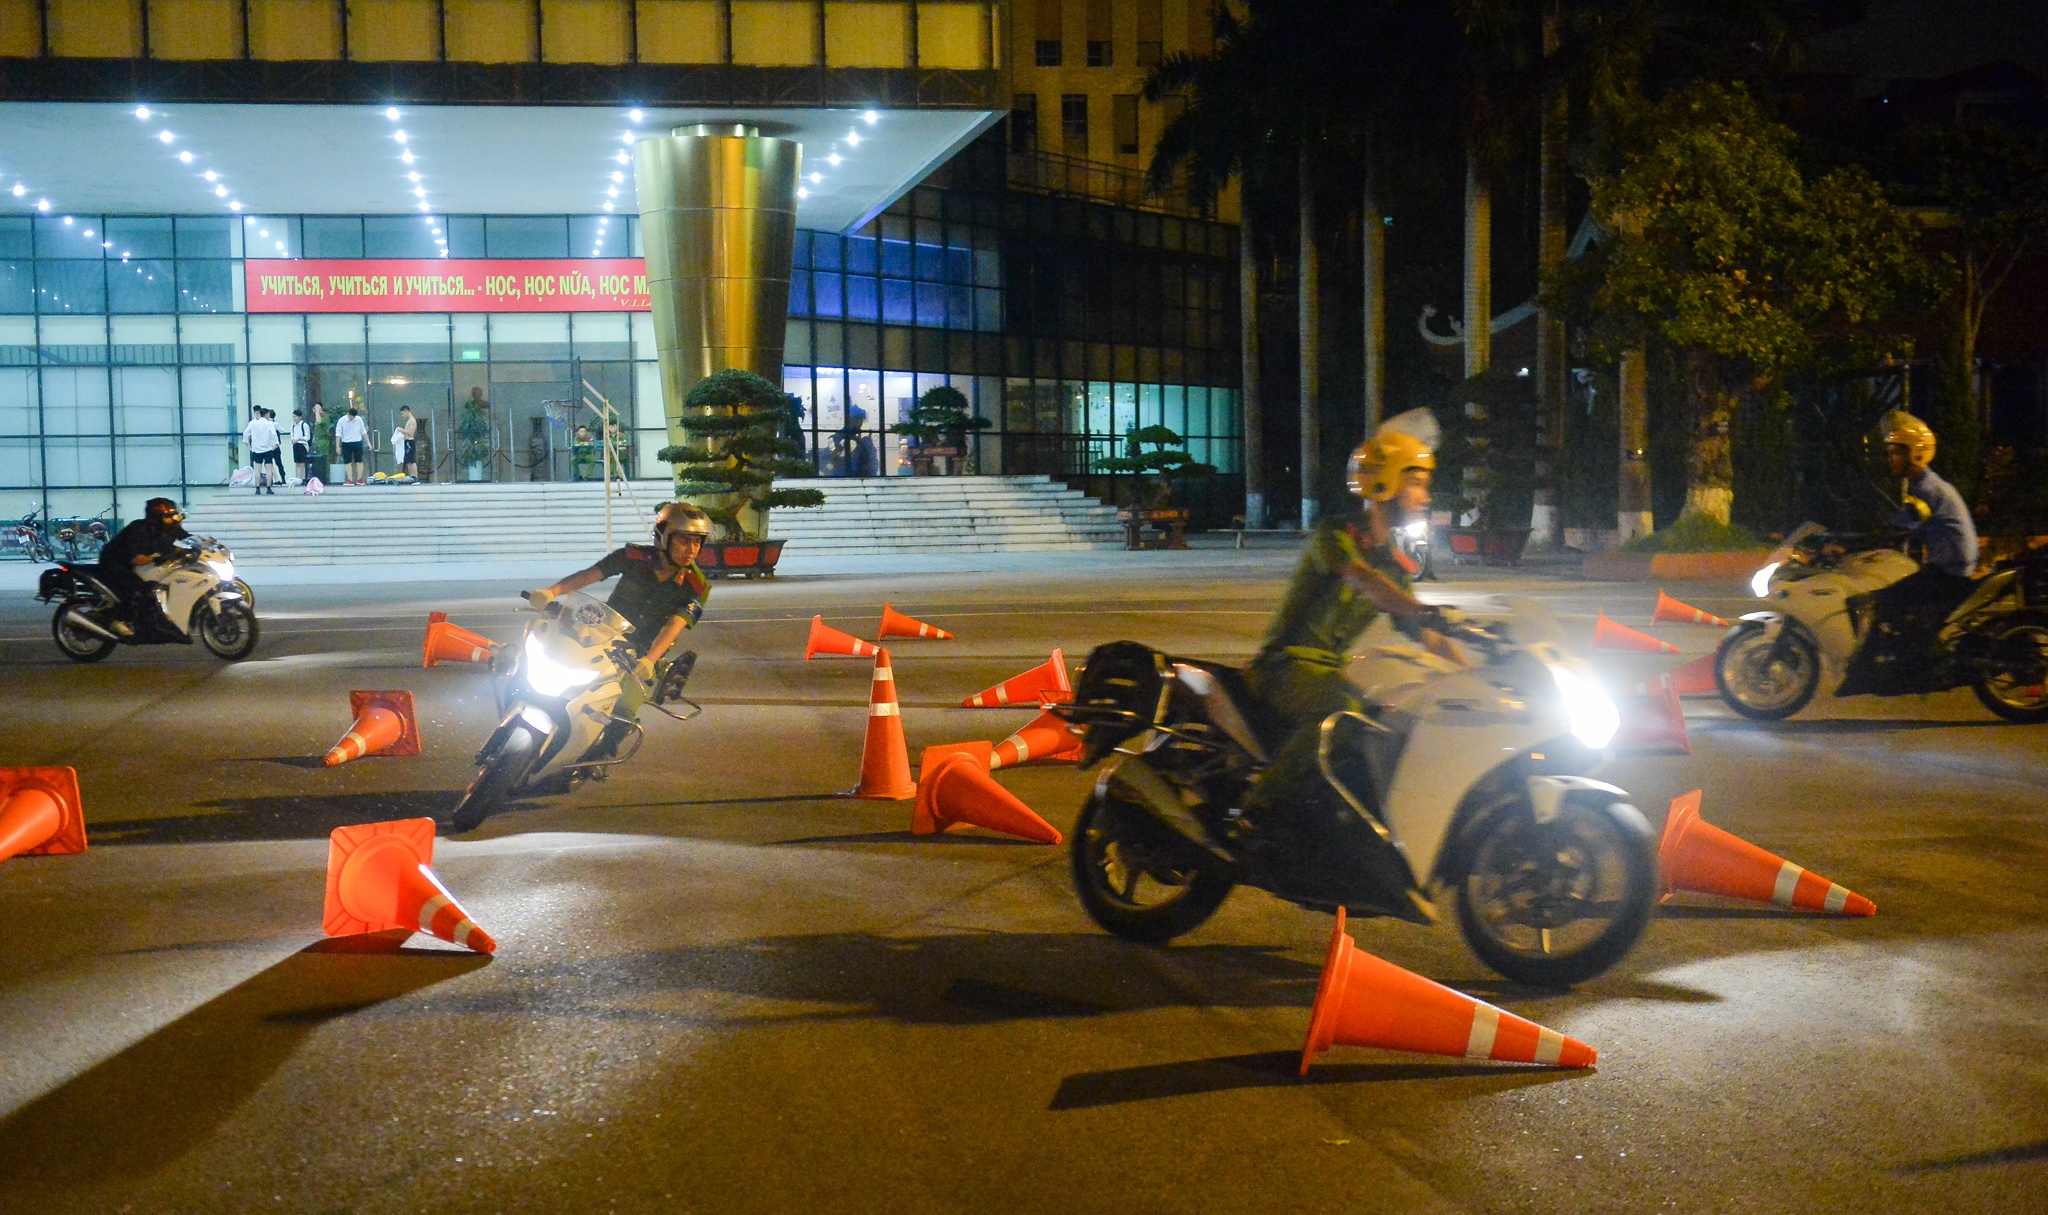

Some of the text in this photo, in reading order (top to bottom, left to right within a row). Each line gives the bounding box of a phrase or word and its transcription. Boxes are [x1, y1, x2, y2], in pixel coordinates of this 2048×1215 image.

[261, 275, 325, 299] УЧИТЬСЯ,
[329, 275, 388, 296] УЧИТЬСЯ
[393, 276, 403, 296] И
[406, 275, 475, 296] УЧИТЬСЯ...
[485, 275, 521, 302] HỌC,
[524, 275, 555, 302] HỌC
[559, 270, 596, 299] NỮA,
[600, 275, 630, 302] HỌC
[633, 275, 650, 295] M
